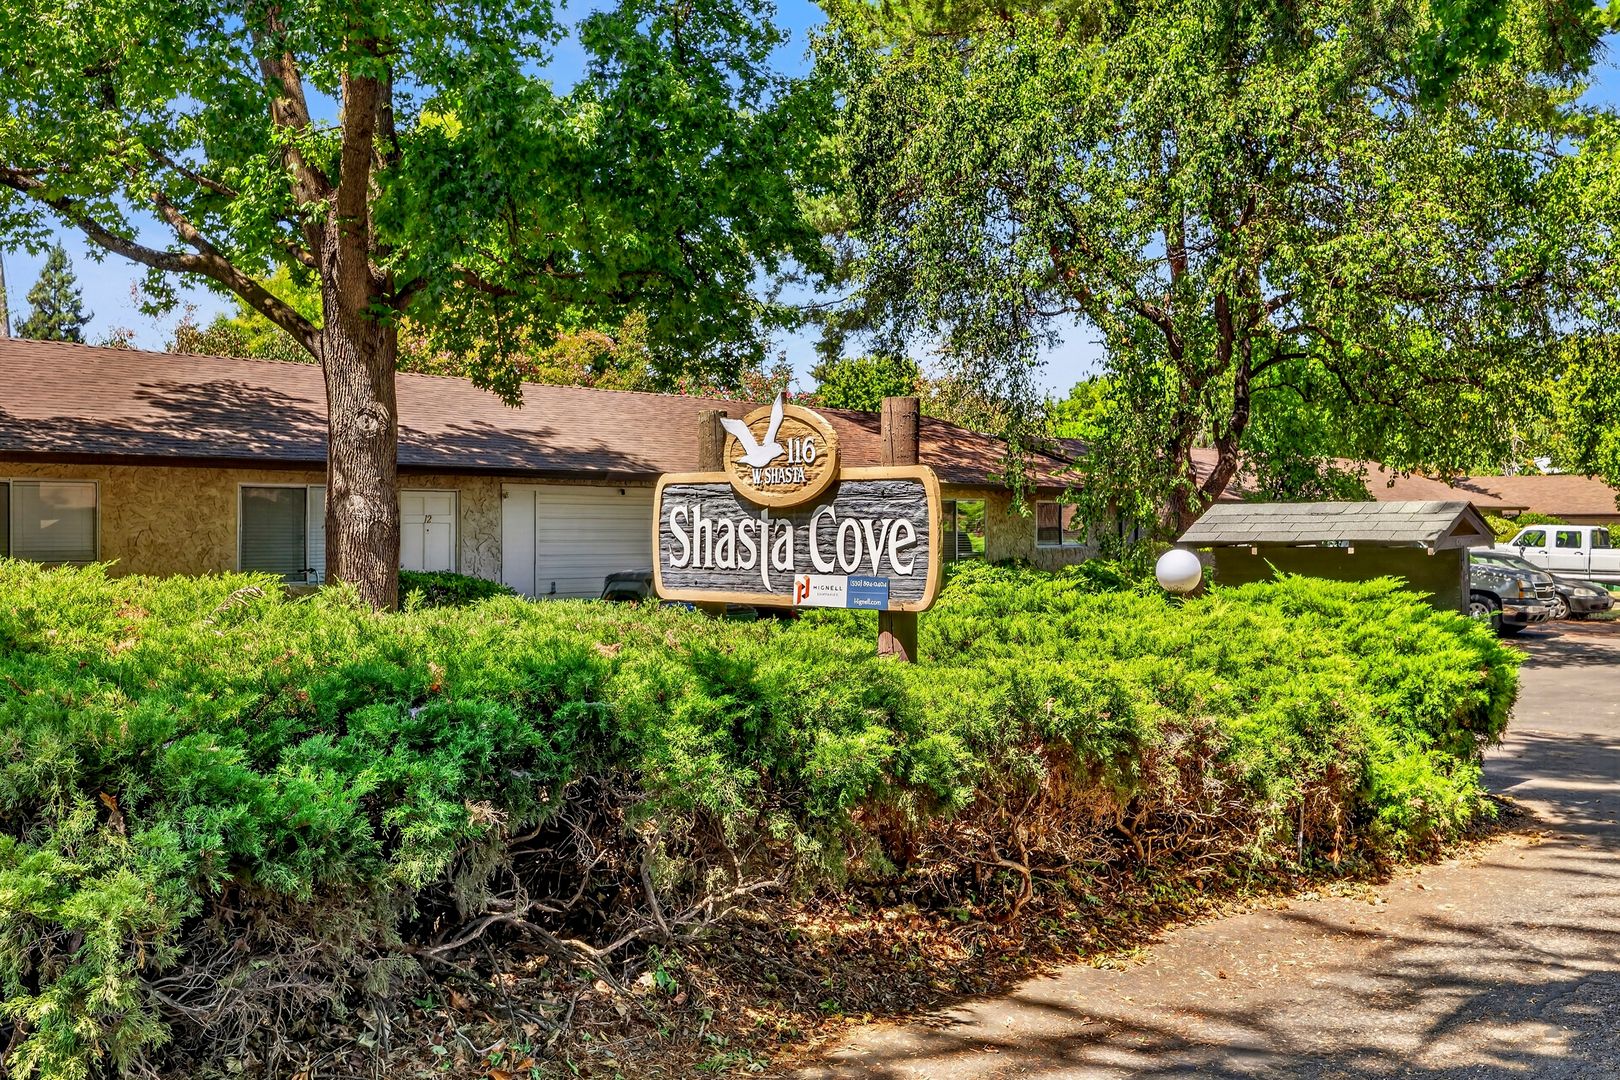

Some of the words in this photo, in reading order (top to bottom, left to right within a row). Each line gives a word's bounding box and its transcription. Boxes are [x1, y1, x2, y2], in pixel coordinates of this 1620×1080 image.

[787, 437, 816, 464] 116
[752, 468, 763, 484] W.
[764, 467, 806, 484] SHASTA
[424, 514, 432, 524] 12
[669, 504, 795, 592] Shasta
[809, 504, 917, 576] Cove
